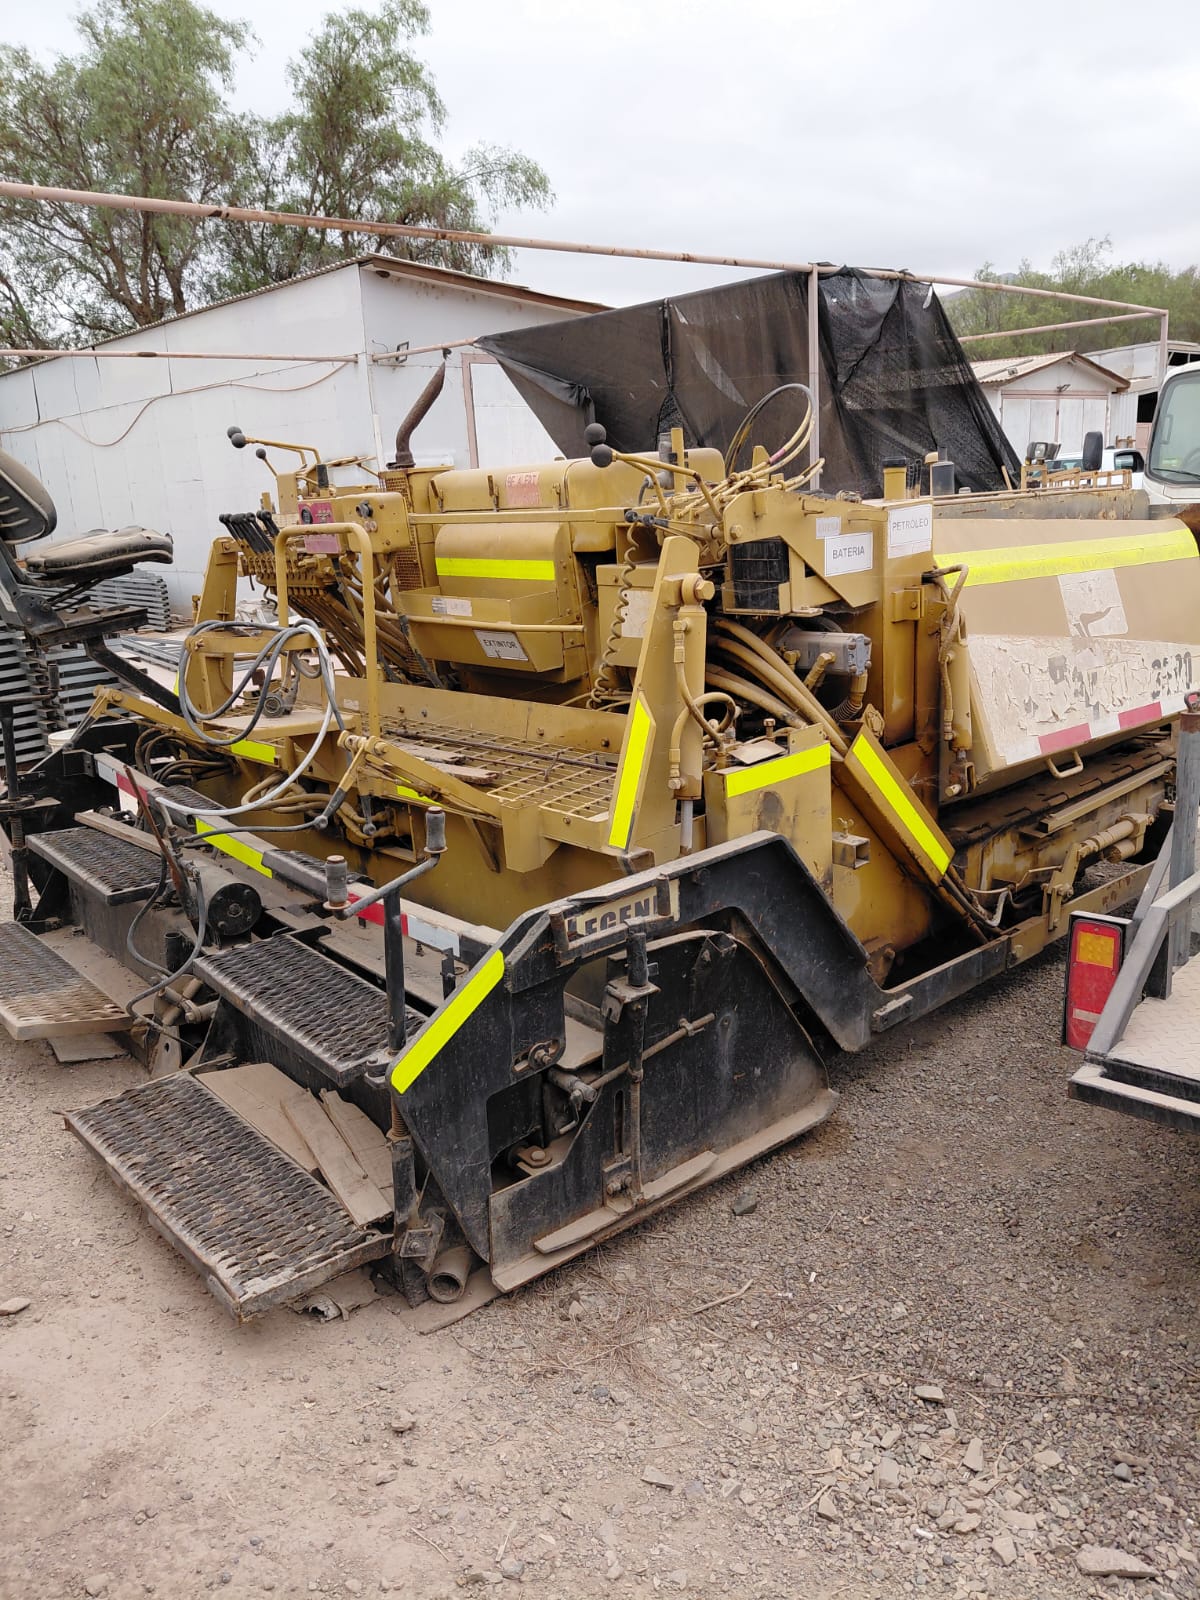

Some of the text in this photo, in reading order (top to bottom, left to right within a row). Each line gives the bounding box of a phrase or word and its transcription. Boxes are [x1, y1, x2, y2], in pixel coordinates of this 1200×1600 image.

[892, 518, 929, 531] PETROLEO
[832, 545, 865, 560] BATERIA
[482, 638, 519, 649] EXTINTOR
